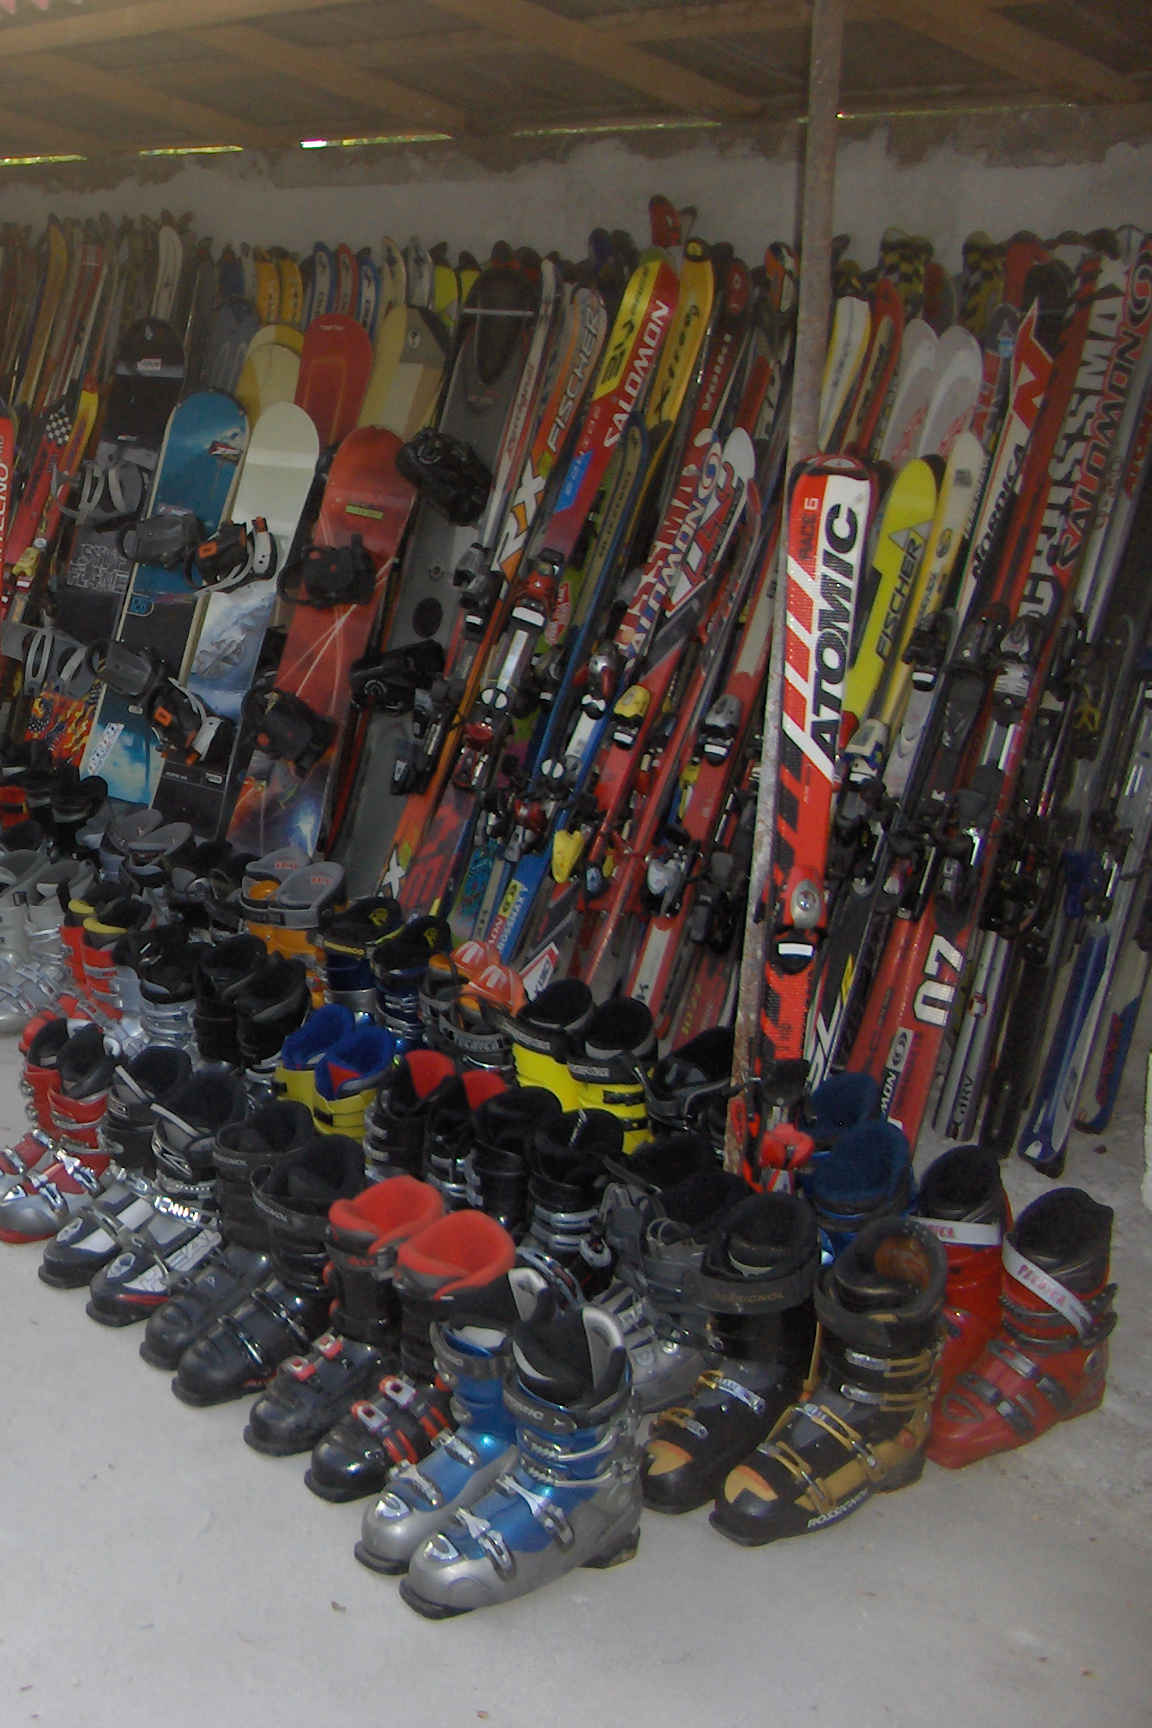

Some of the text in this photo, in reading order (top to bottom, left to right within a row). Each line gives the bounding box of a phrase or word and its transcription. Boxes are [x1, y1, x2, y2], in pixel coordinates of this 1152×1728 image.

[604, 299, 671, 448] SALOMON
[1055, 330, 1144, 569] SALOMON
[810, 503, 858, 760] ATOMIC
[876, 536, 924, 662] FISCHER
